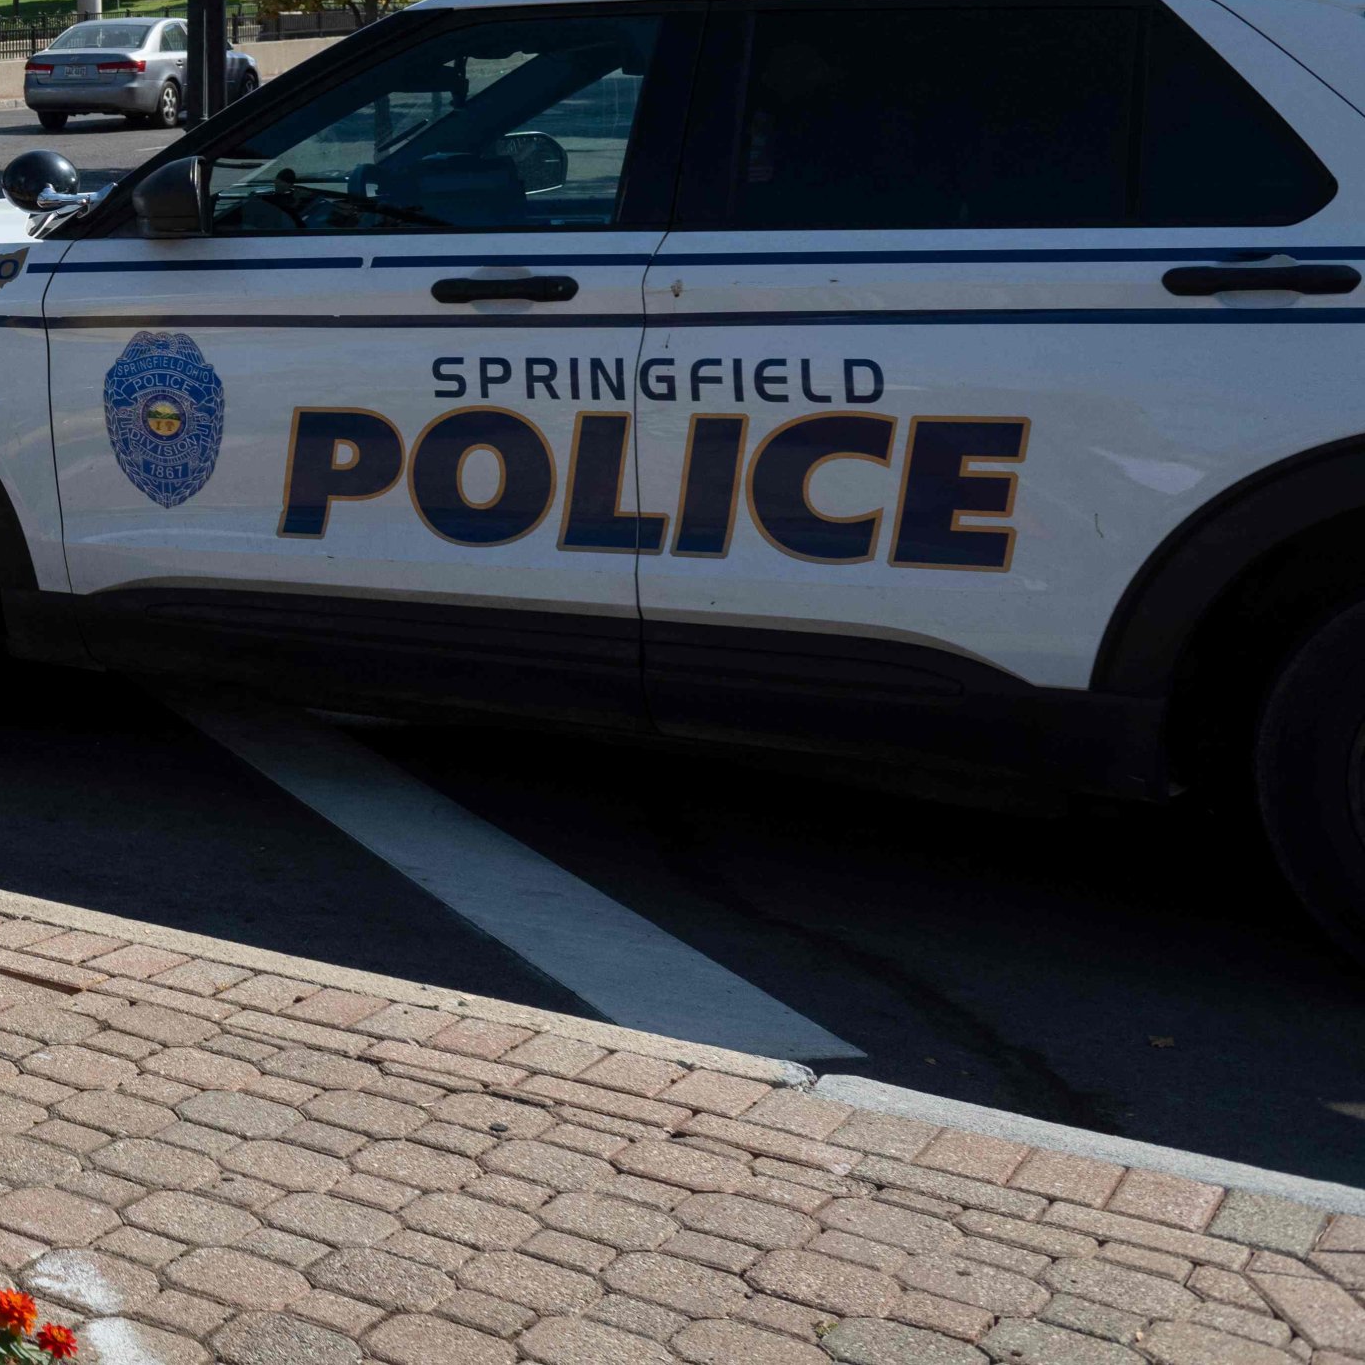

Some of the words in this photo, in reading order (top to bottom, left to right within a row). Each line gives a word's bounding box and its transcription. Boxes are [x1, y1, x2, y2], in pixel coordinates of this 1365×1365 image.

[116, 355, 184, 377] SPRINGFIELD
[186, 363, 210, 383] OHIO
[432, 355, 885, 405] SPRINGFIELD
[132, 374, 194, 395] POLICE
[130, 428, 198, 457] DIVISION
[149, 463, 184, 479] 1867
[276, 405, 1033, 574] POLICE
